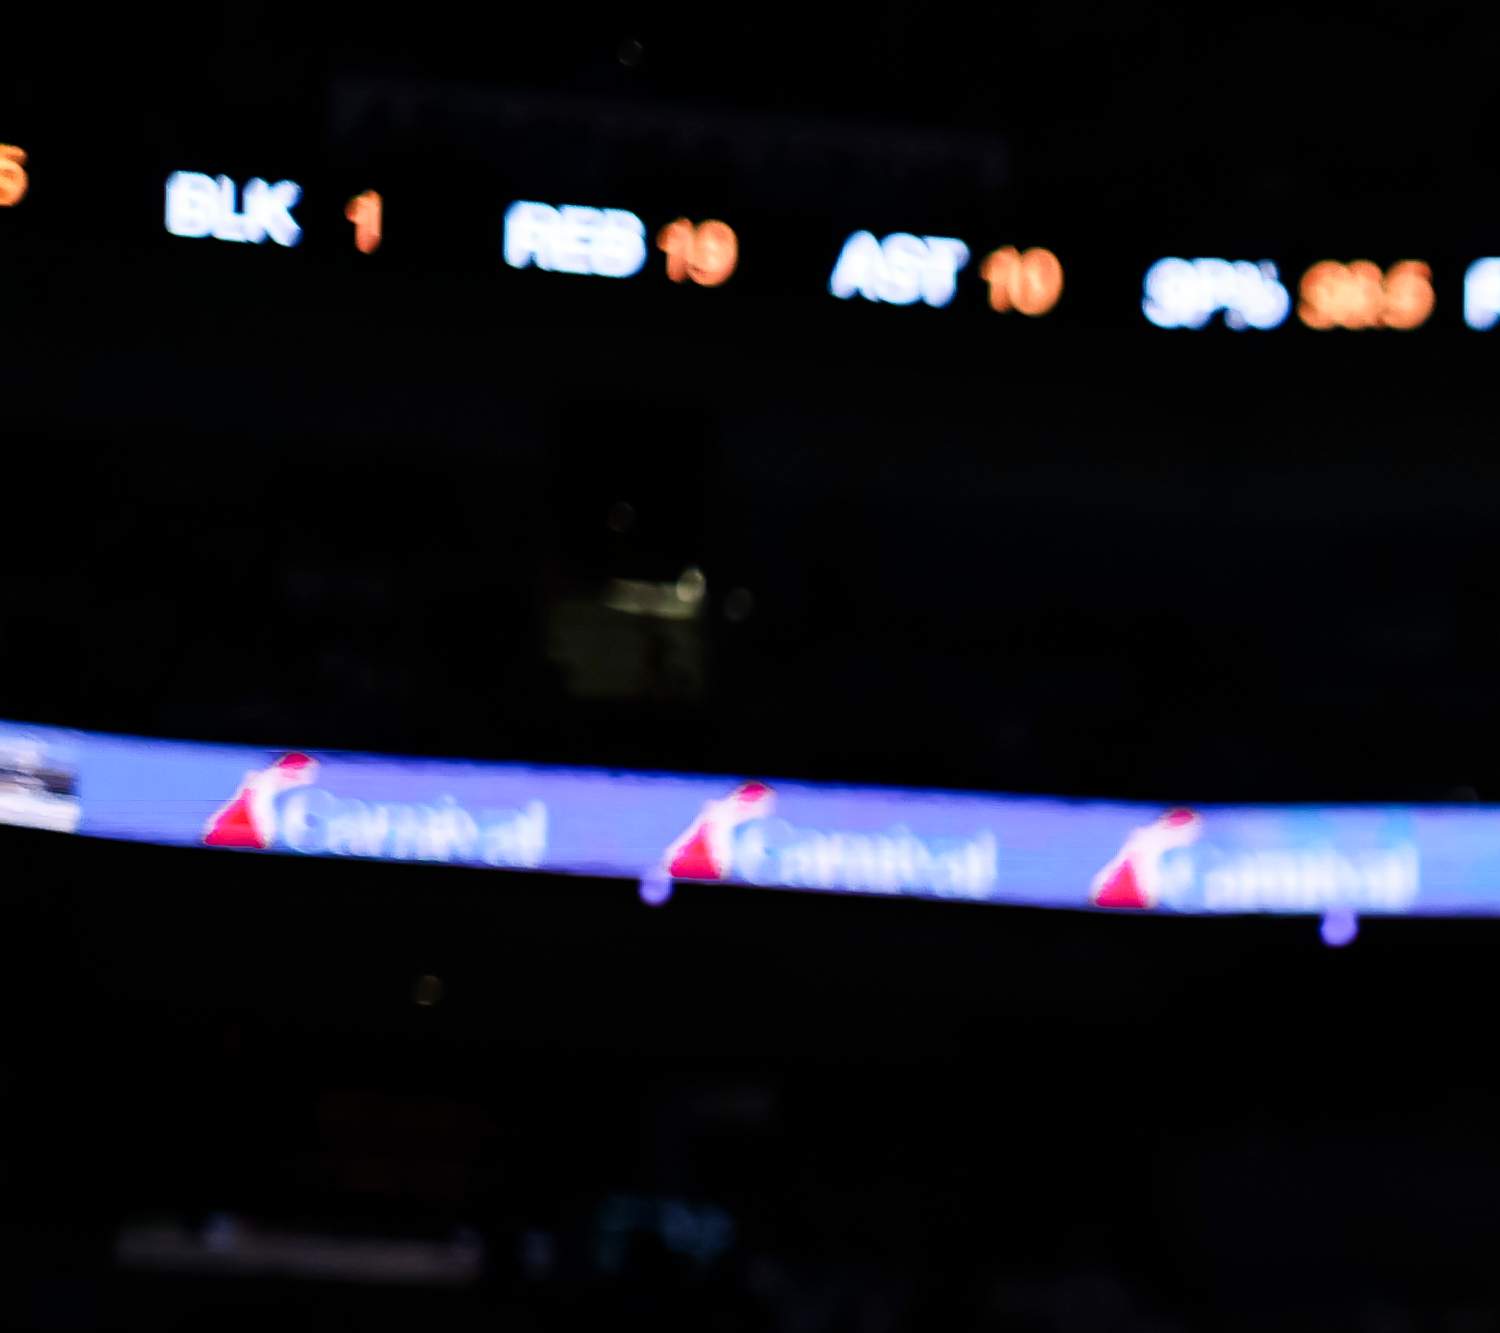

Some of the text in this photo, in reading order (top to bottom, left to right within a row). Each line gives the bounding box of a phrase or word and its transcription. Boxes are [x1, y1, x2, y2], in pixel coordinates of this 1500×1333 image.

[164, 170, 301, 247] BLK
[346, 189, 383, 253] 1
[504, 200, 648, 278] REB
[829, 230, 971, 308] AST
